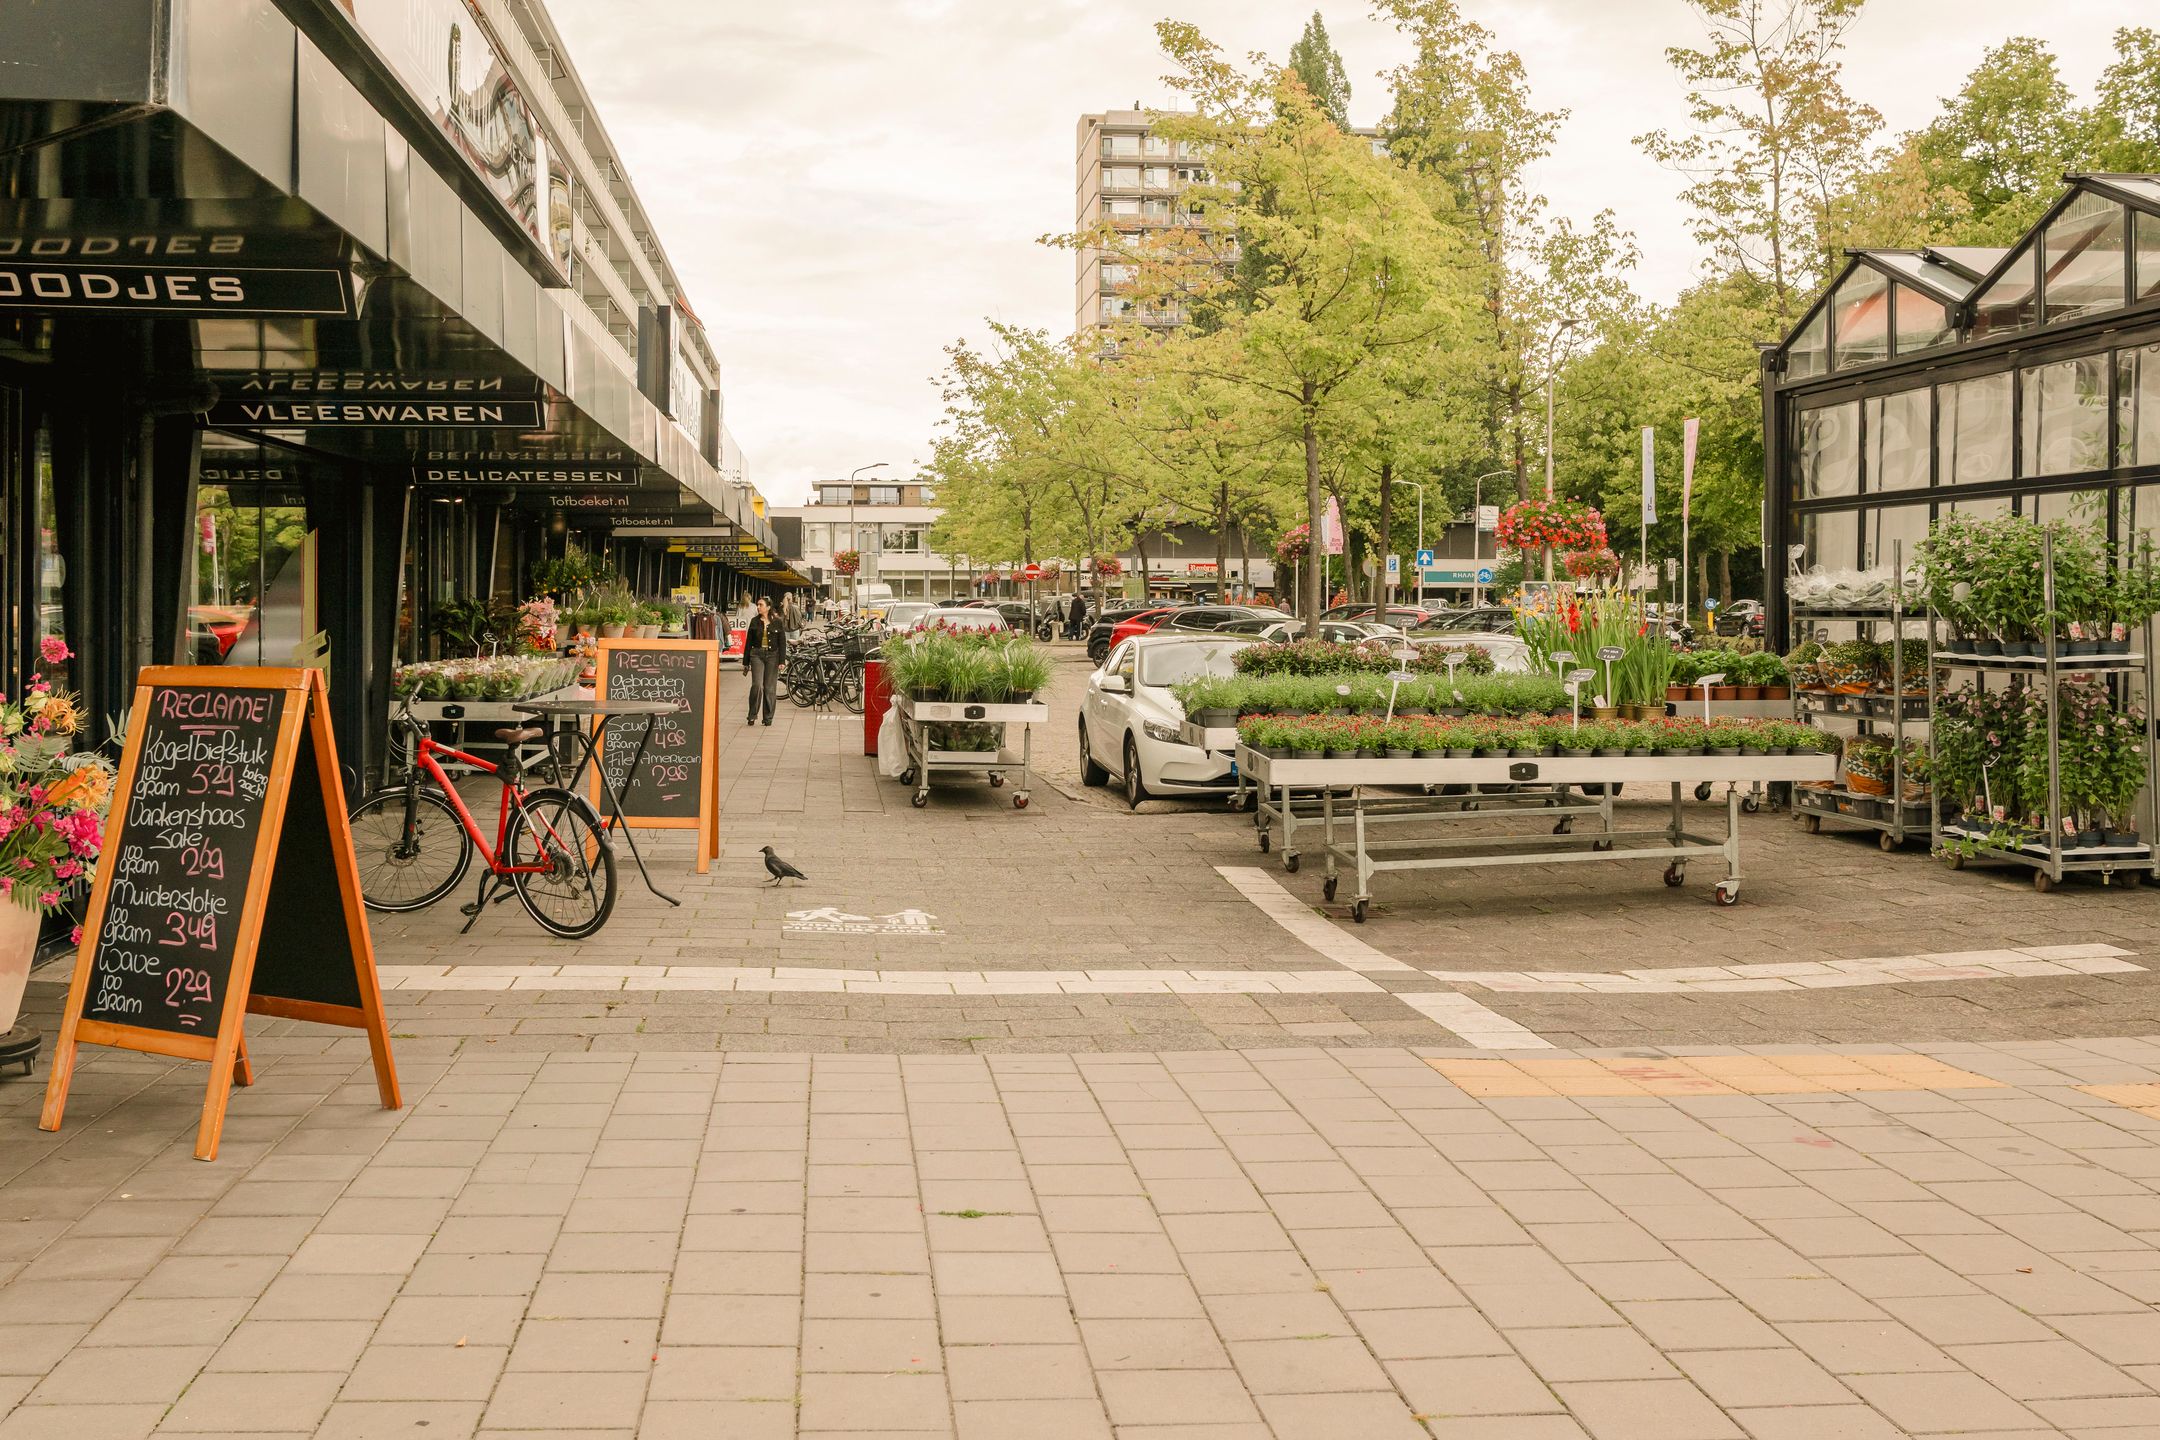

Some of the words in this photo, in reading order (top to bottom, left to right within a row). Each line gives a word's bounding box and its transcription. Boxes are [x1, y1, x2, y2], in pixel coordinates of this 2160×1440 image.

[241, 405, 503, 422] VLEESWAREN
[428, 470, 622, 482] DELICATESSEN
[549, 495, 630, 507] Tofboeket.nl
[610, 517, 674, 526] Tofboeket.nl
[729, 618, 746, 628] ale
[157, 689, 274, 729] RECLAME!
[607, 731, 622, 741] 100
[605, 740, 642, 752] gram
[640, 750, 702, 765] American
[141, 765, 162, 781] 100
[608, 767, 624, 777] 100
[133, 780, 180, 801] gram
[122, 845, 143, 861] 100
[113, 858, 160, 882] gram
[109, 904, 129, 924] 100
[100, 921, 152, 947] gram
[102, 974, 122, 991] 100
[92, 989, 142, 1014] gram
